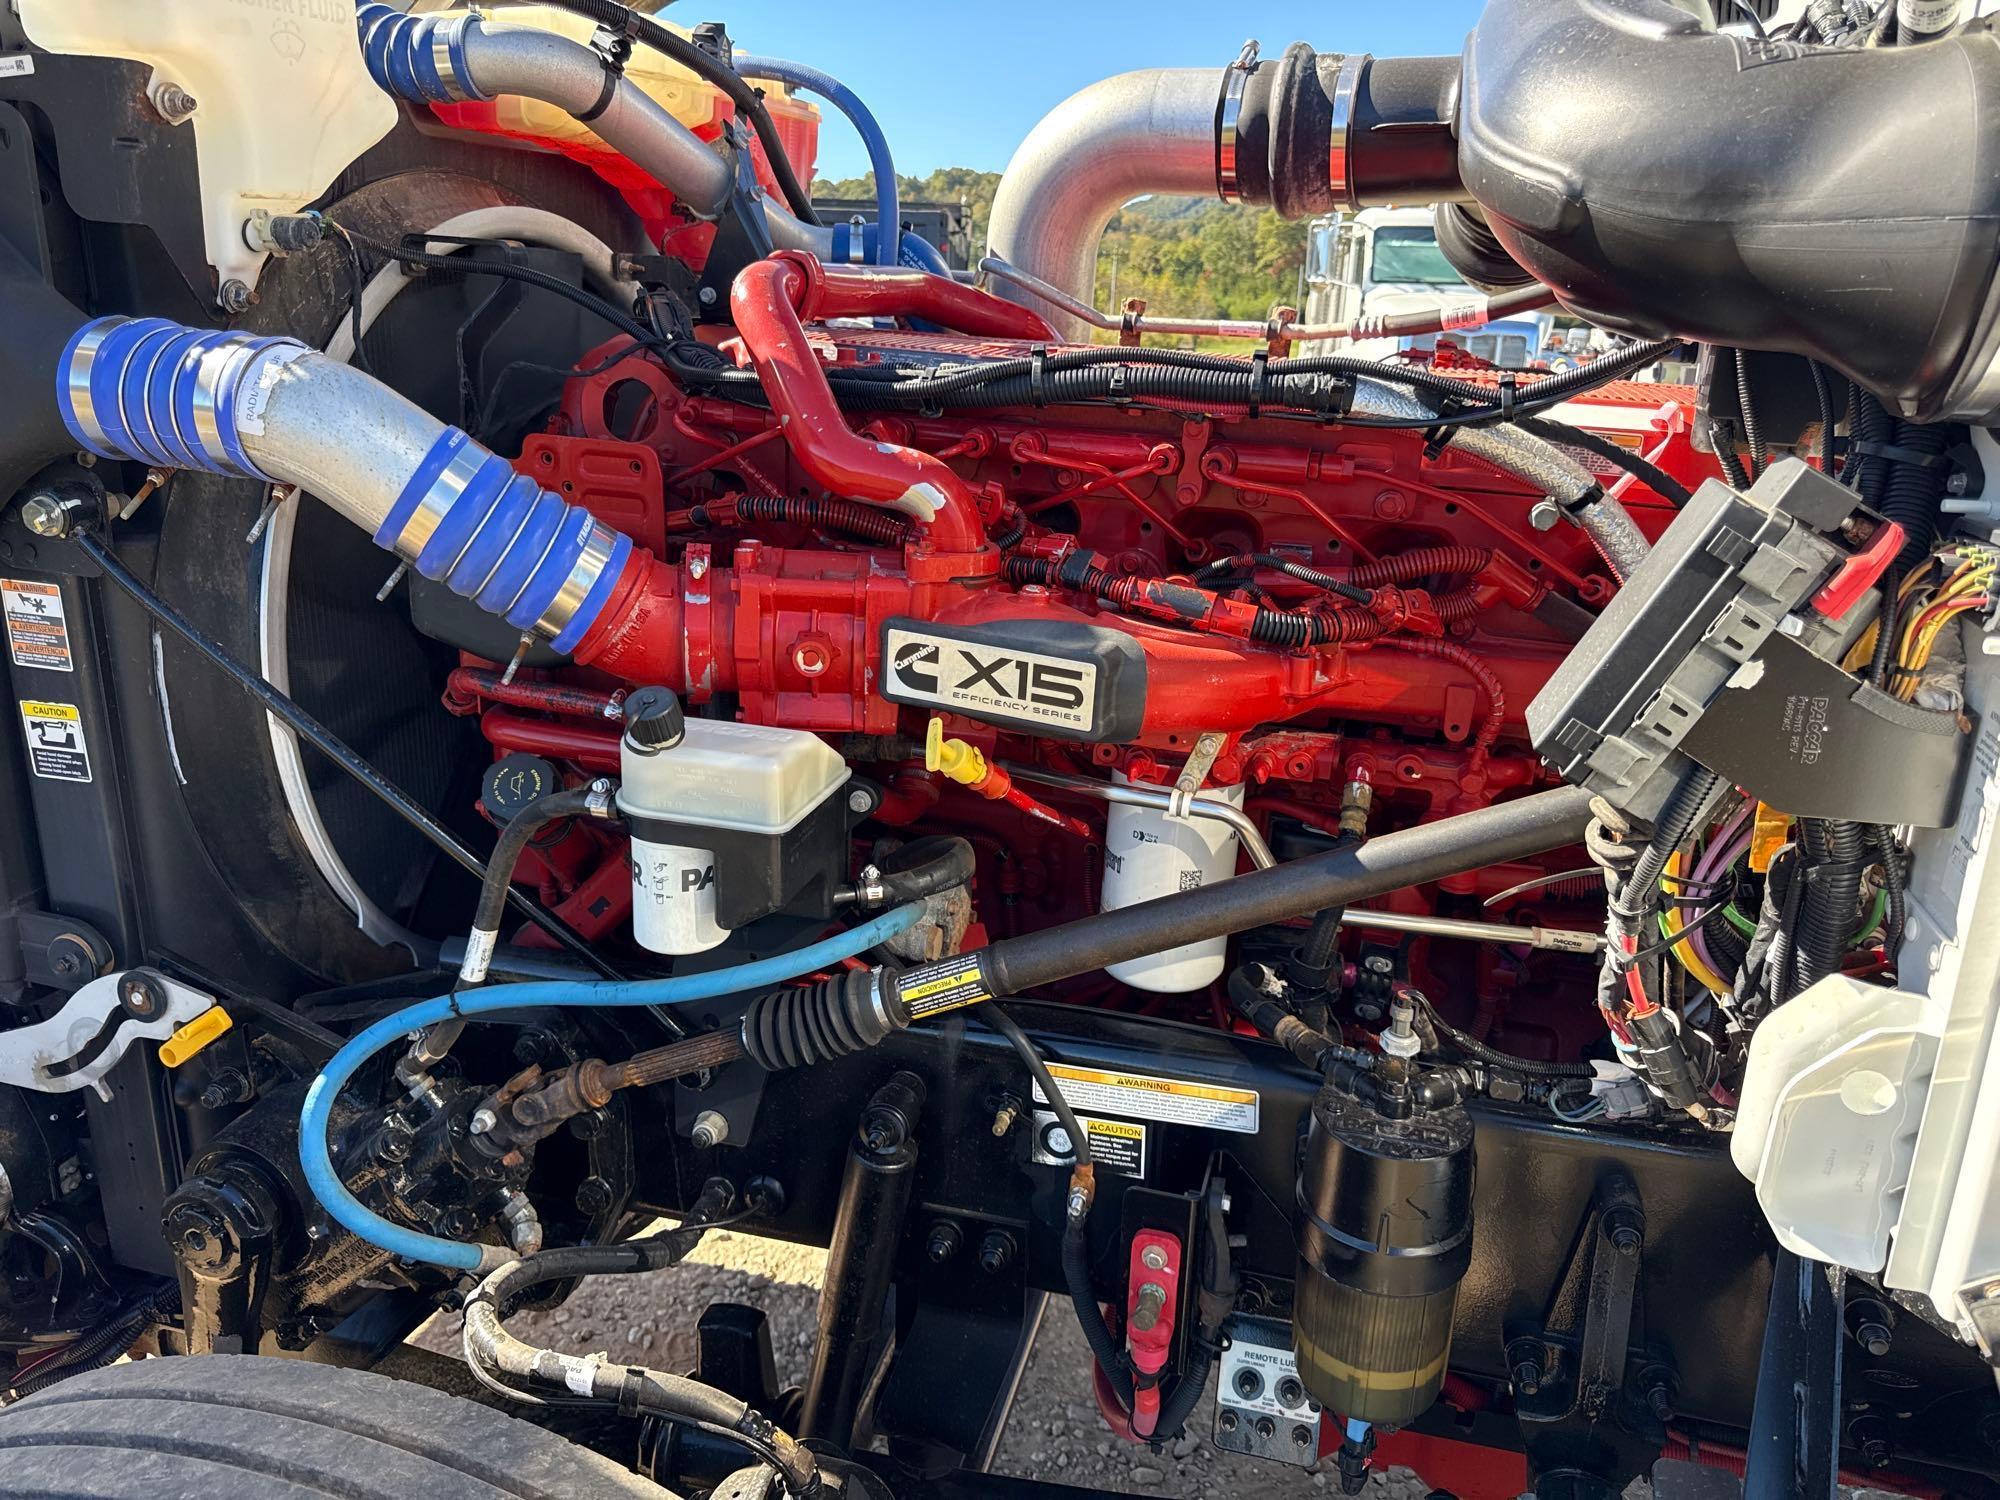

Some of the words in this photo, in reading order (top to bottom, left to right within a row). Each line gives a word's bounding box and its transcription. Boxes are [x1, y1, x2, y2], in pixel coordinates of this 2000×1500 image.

[20, 584, 48, 594] WARNING
[894, 644, 936, 669] Cummins
[954, 649, 1084, 710] X15
[32, 706, 68, 717] CAUTION
[952, 691, 1029, 712] EFFICIENCY
[1032, 706, 1082, 722] SERIES
[1801, 697, 1829, 764] PACCAR
[530, 769, 542, 791] ENGINE
[527, 792, 538, 801] OIL
[1124, 1078, 1170, 1092] WARNING
[1097, 1124, 1141, 1137] CAUTION
[1244, 1350, 1278, 1365] REMOTE
